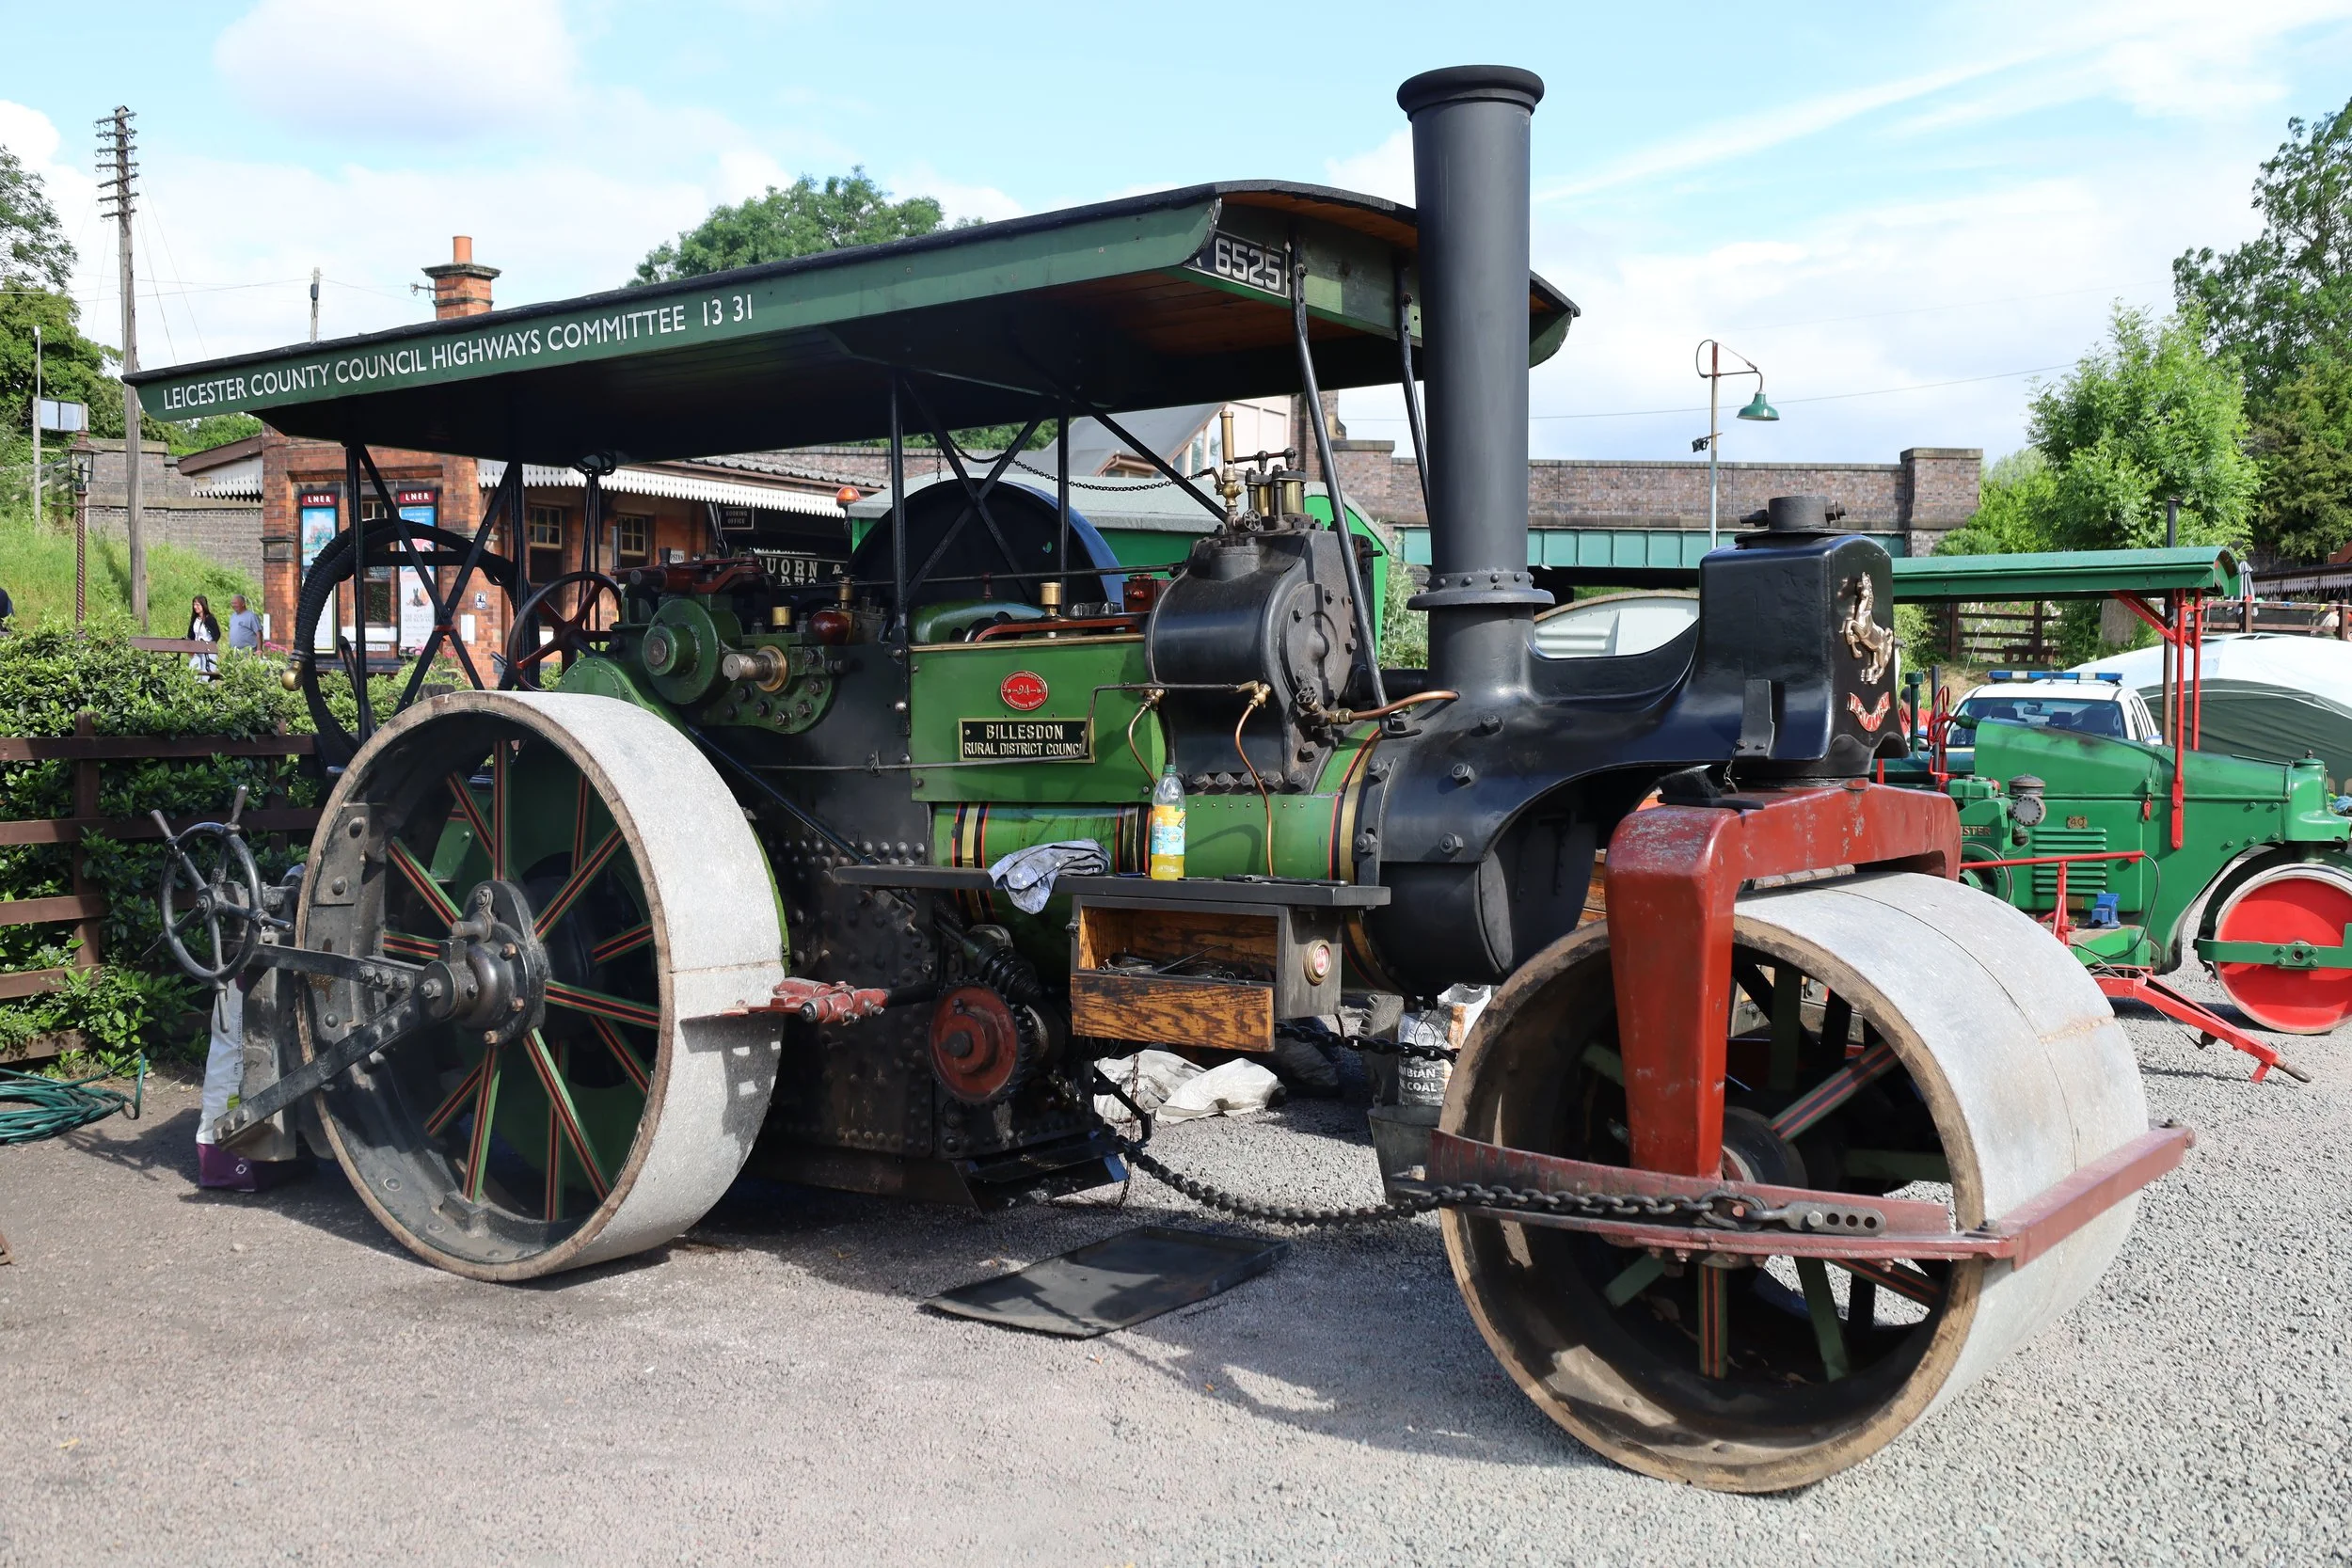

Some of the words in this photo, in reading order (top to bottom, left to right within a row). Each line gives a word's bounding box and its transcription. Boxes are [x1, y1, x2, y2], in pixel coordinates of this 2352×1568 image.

[1215, 237, 1280, 291] 6525
[163, 376, 247, 411] LEICESTER
[250, 362, 331, 397] COUNTY
[335, 348, 427, 384] COUNCIL
[432, 329, 542, 370] HIGHWAYS
[548, 305, 686, 351] COMMITTEE
[703, 298, 723, 327] 13
[732, 293, 754, 322] 31
[307, 495, 331, 503] LNER
[405, 492, 429, 500] LNER
[986, 724, 1064, 740] BILLESDON
[964, 742, 998, 755] RURAL
[1000, 743, 1043, 756] DISTRICT
[1046, 743, 1089, 756] COUNC
[1960, 825, 1992, 836] ISTER
[1398, 1065, 1437, 1079] MBIAN
[1406, 1081, 1438, 1093] COAL
